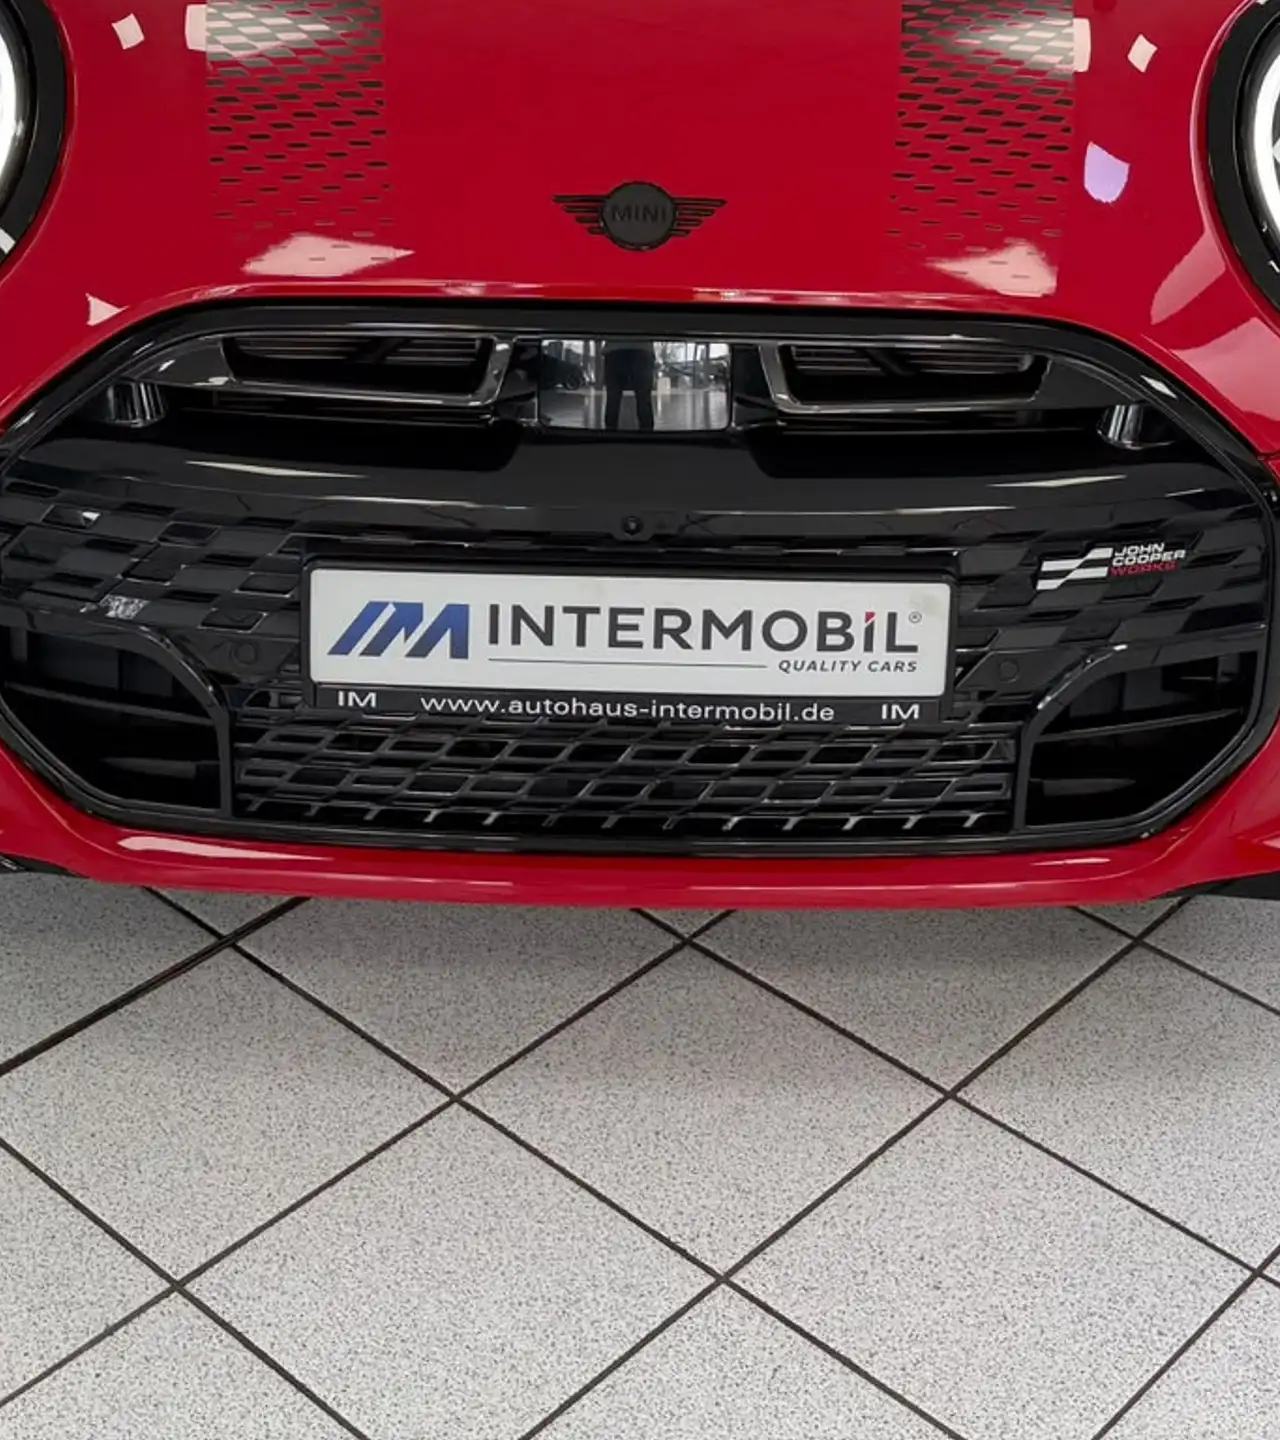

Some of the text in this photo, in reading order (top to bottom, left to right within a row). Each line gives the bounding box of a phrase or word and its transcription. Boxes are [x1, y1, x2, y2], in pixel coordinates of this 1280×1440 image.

[612, 204, 666, 222] MINI
[1112, 549, 1186, 567] COOPER
[1114, 542, 1165, 557] JOHN
[1110, 561, 1180, 577] WORKS
[778, 660, 918, 675] QUALITY CARS
[337, 690, 920, 722] IM www.autohaus-intermobil.de IM
